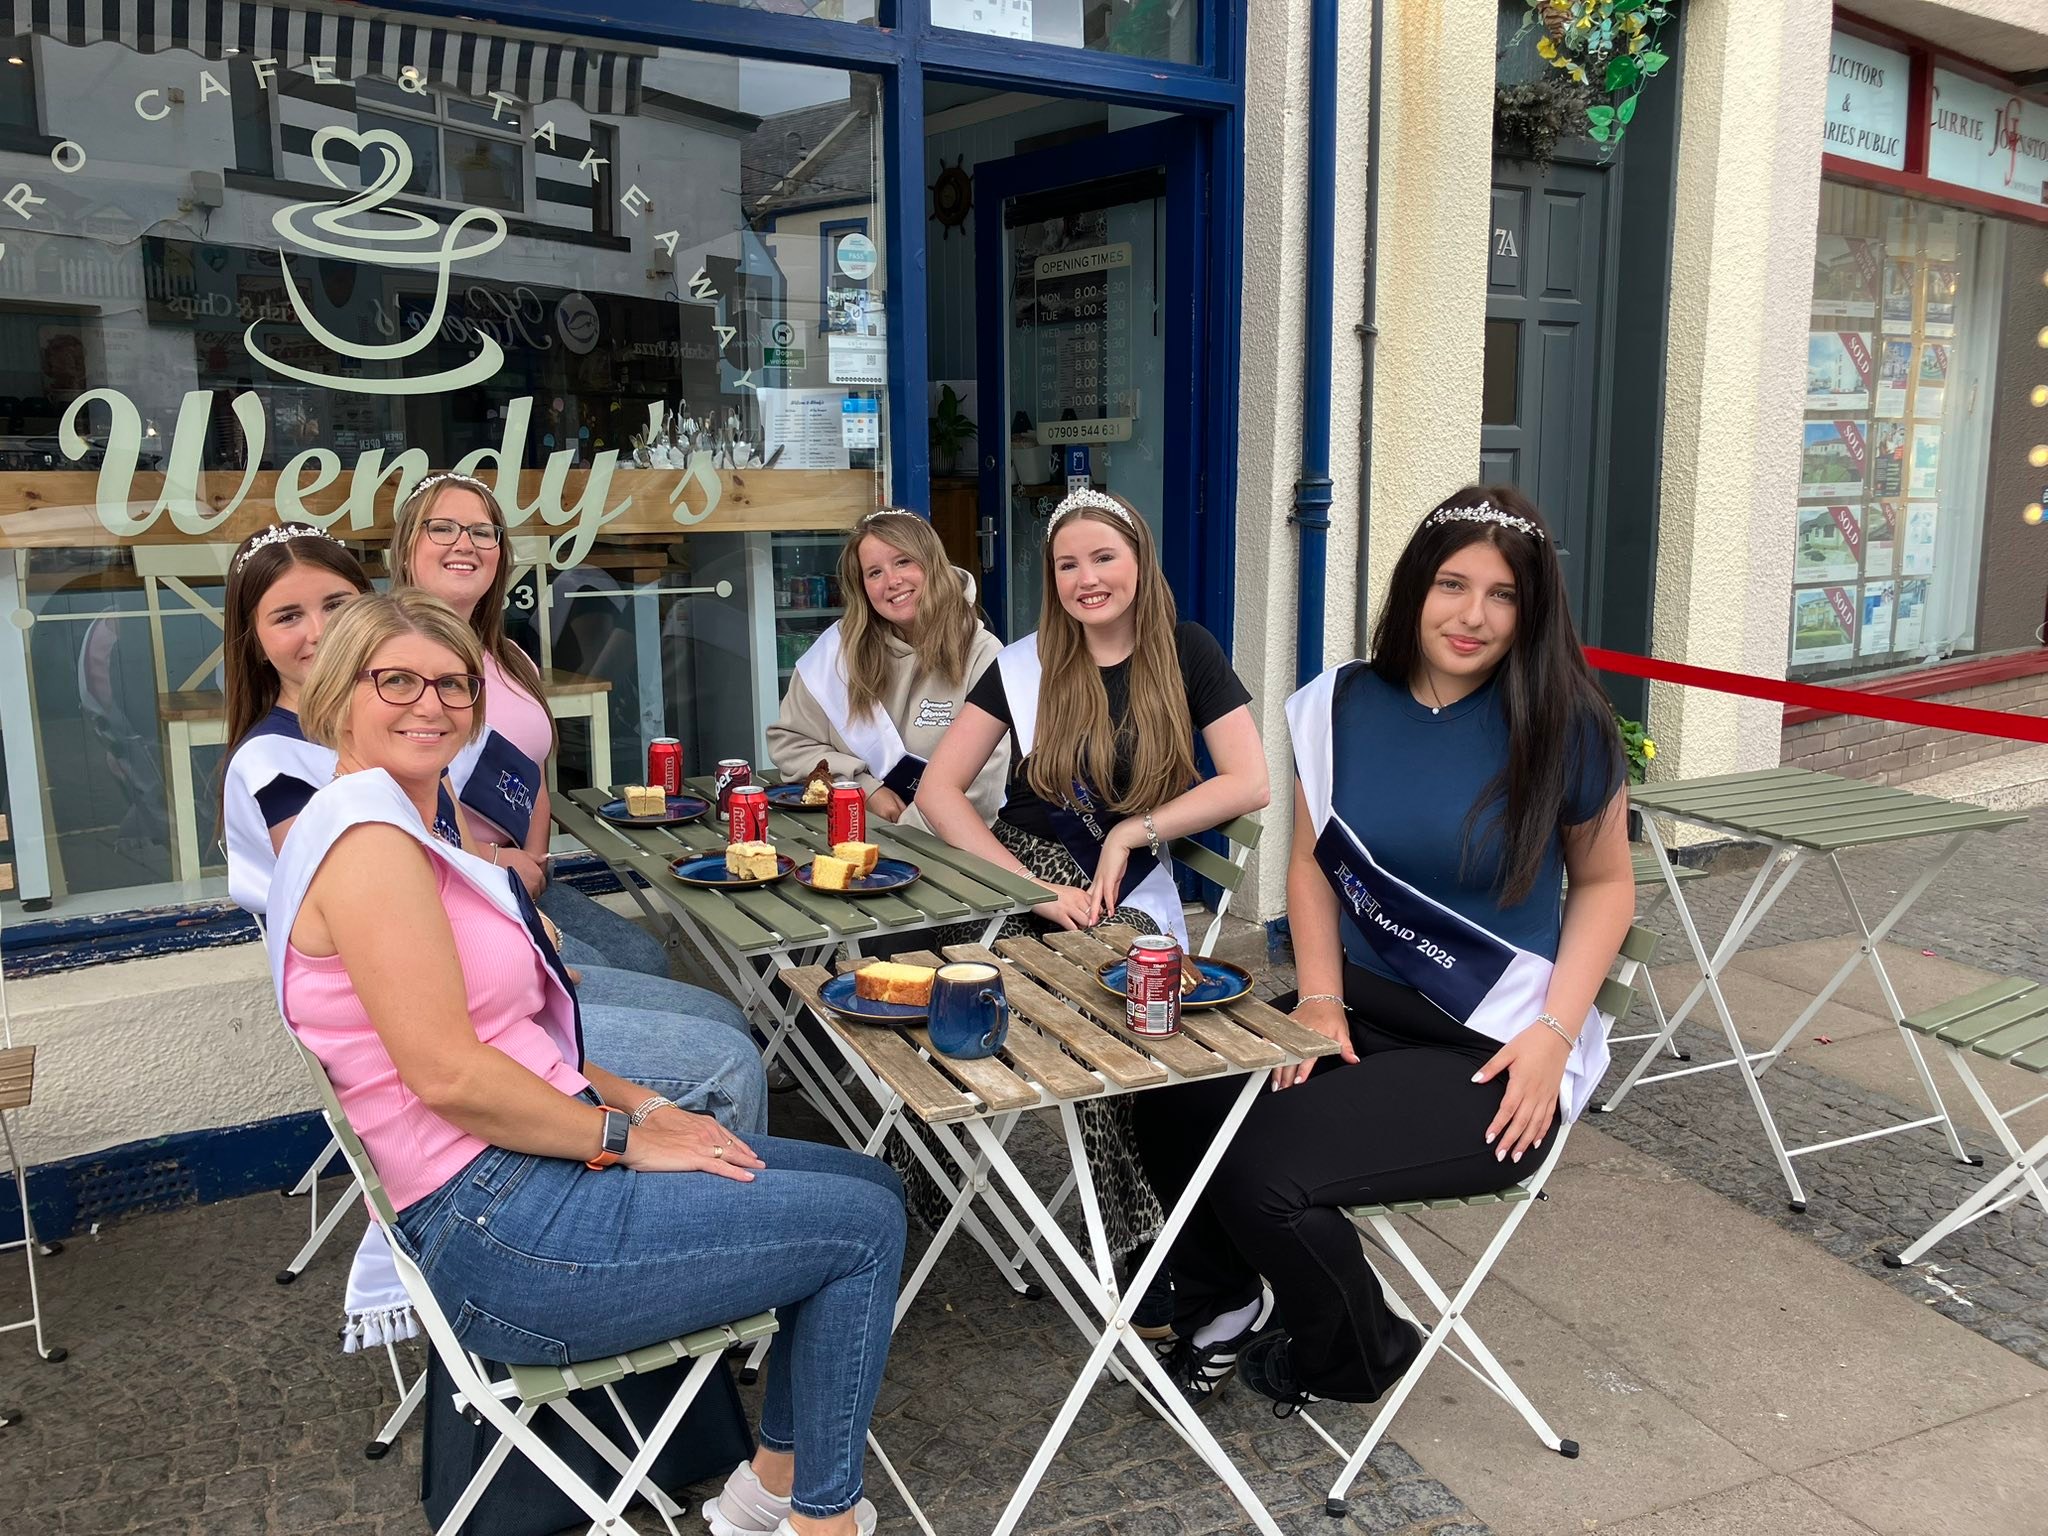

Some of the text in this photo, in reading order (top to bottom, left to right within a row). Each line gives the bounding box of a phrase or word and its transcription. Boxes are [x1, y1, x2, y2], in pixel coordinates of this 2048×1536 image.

[1842, 93, 1851, 113] &
[1856, 129, 1900, 157] PUBLIC
[134, 56, 340, 121] CAFE
[398, 65, 427, 96] &
[488, 90, 757, 391] TAKEAWAY
[1494, 228, 1519, 258] 7A
[1042, 250, 1124, 274] OPENING TIMES
[1040, 292, 1061, 303] MON
[1041, 311, 1058, 320] TUE
[1041, 328, 1061, 338] WED
[769, 358, 800, 366] welcome
[775, 350, 793, 358] Dogs
[1848, 336, 1870, 374] SOLD
[1041, 399, 1060, 409] SUN
[1048, 424, 1120, 439] 07909 544 631
[1843, 424, 1865, 462] SOLD
[59, 388, 722, 570] Wendy's
[1838, 510, 1859, 546] SOLD
[1832, 591, 1853, 626] SOLD
[1082, 813, 1105, 841] QUEEN
[1374, 912, 1416, 942] MAID
[1416, 938, 1457, 970] 2025
[1168, 990, 1174, 1001] ME
